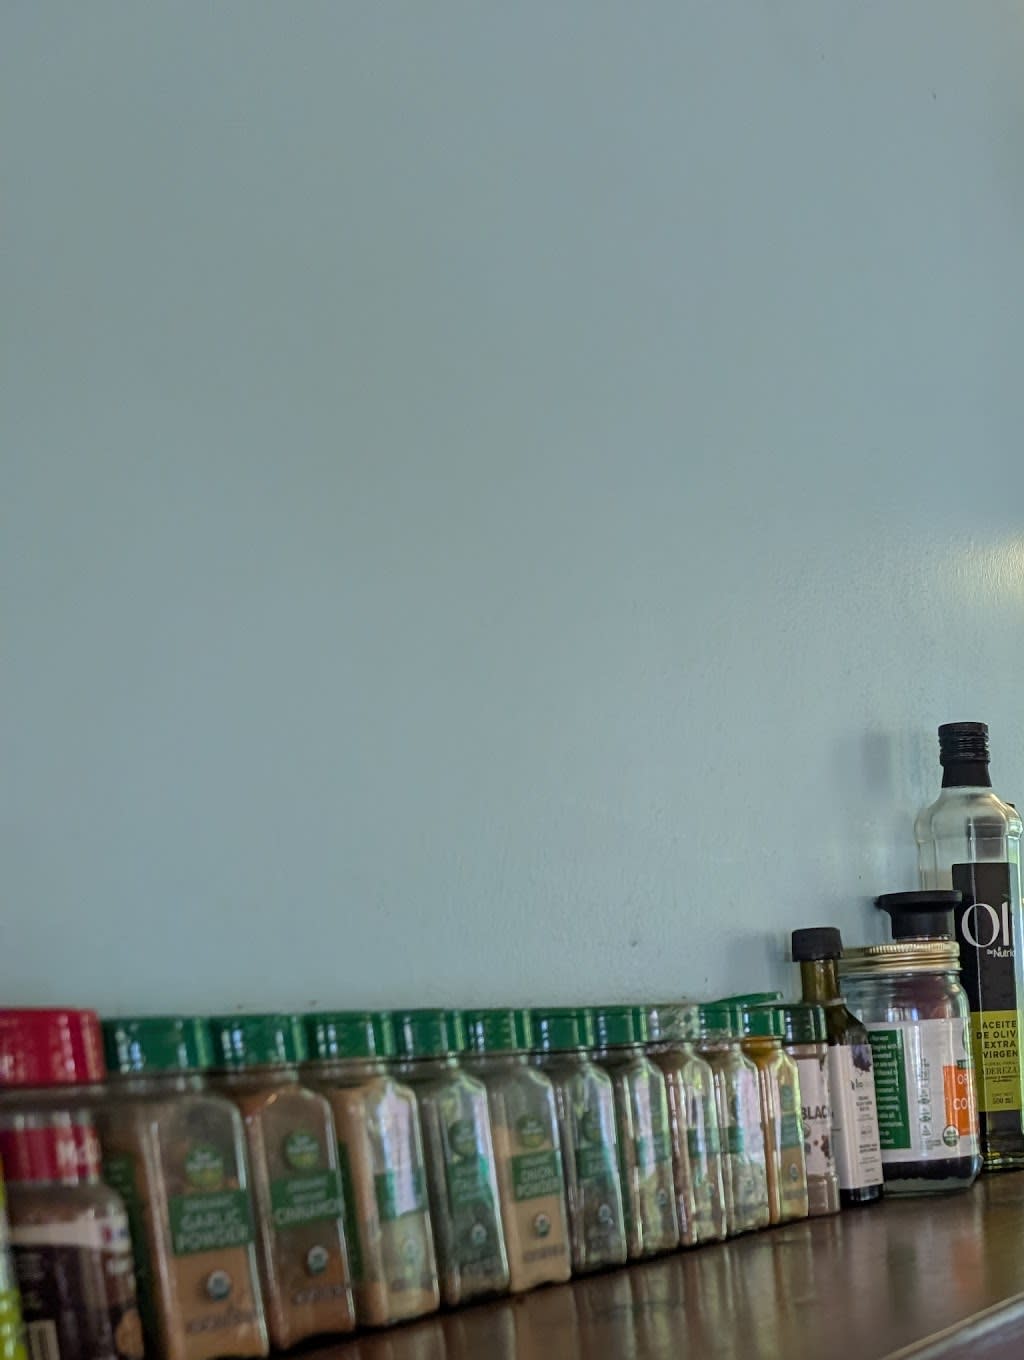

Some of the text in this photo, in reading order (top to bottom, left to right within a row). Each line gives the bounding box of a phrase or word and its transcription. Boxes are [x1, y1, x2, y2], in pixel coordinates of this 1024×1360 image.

[982, 1020, 1017, 1029] ACEITE
[976, 1030, 1019, 1040] DE OLIV
[984, 1040, 1016, 1049] EXTRA
[983, 1049, 1019, 1058] VIRGEN
